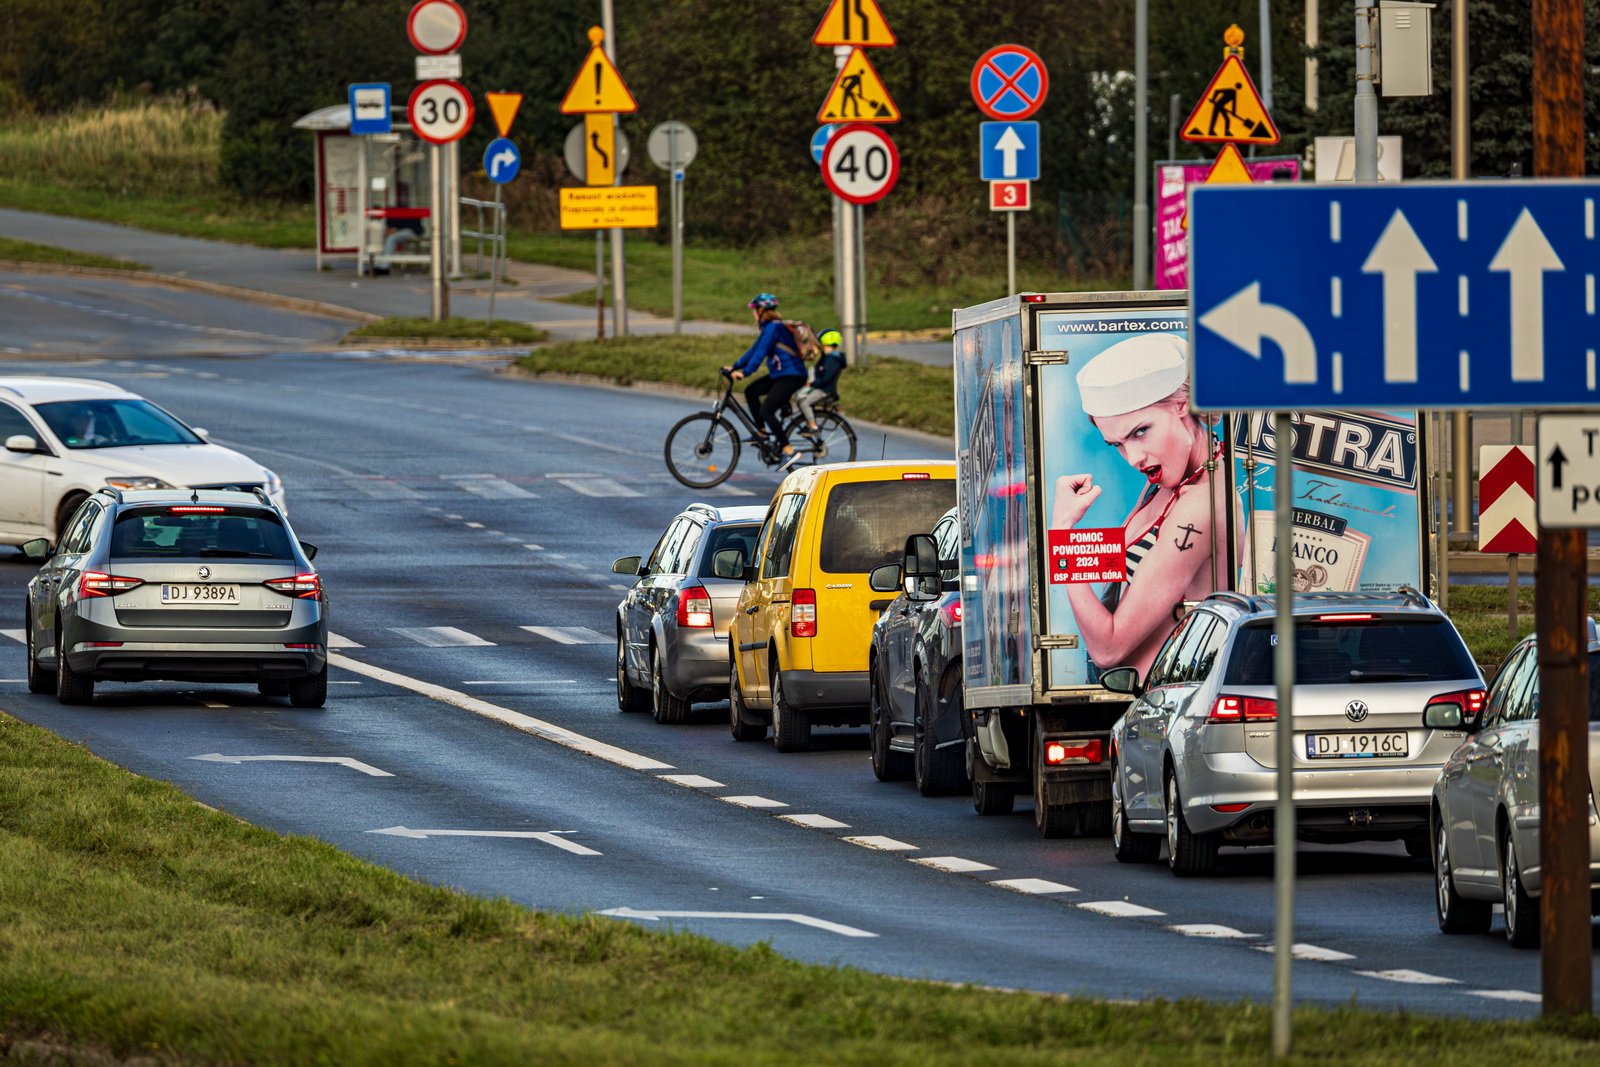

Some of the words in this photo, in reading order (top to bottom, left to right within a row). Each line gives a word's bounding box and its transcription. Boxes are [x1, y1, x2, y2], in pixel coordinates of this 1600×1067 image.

[421, 98, 461, 125] 30
[835, 145, 888, 182] 40
[1003, 186, 1018, 204] 3
[1069, 532, 1104, 543] POMOC
[1052, 543, 1122, 555] POWODZIANOM
[1076, 556, 1099, 567] 2024
[1053, 572, 1069, 582] OSP
[1070, 571, 1101, 581] JELENIA
[1101, 569, 1123, 580] GÓRA
[171, 586, 188, 600] DJ
[193, 586, 236, 600] 9389A
[1318, 735, 1340, 753] DJ
[1349, 735, 1403, 752] 1916C
